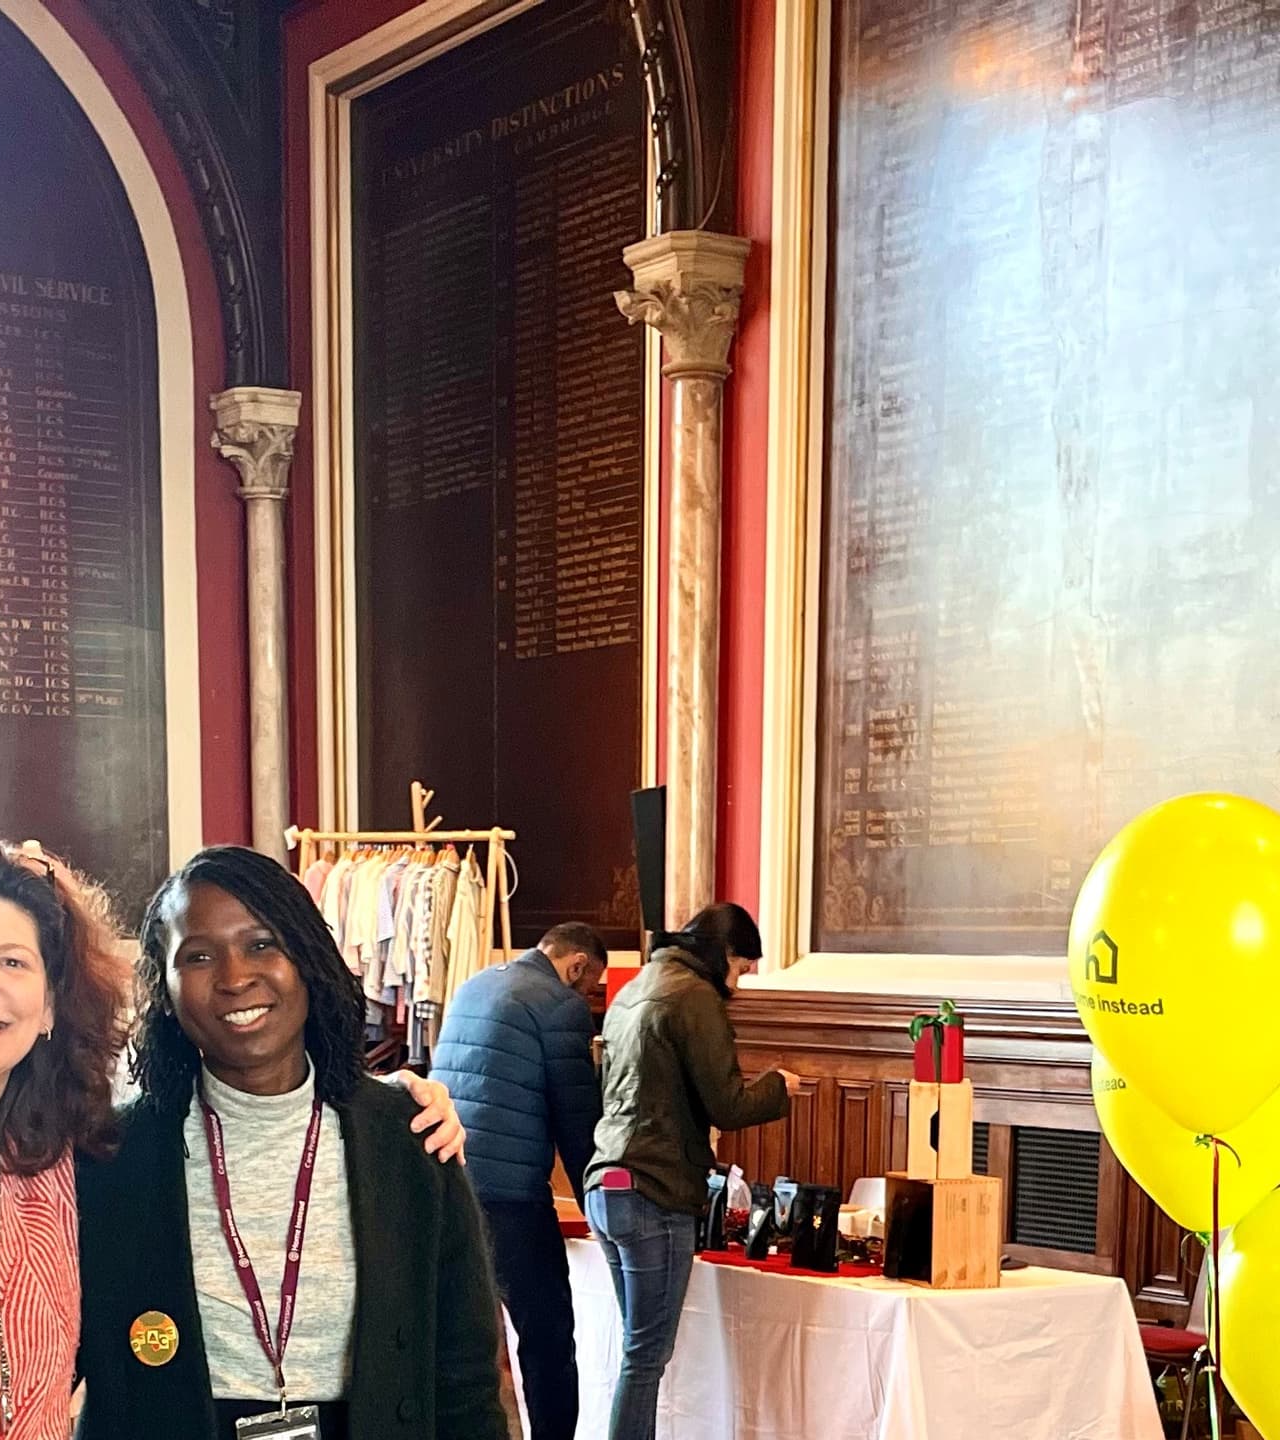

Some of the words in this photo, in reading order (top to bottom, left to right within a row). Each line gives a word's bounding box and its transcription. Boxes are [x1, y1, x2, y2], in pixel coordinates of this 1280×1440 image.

[490, 63, 624, 137] DISTINCTIONS
[34, 277, 113, 305] SERVICE
[1098, 994, 1164, 1015] instead
